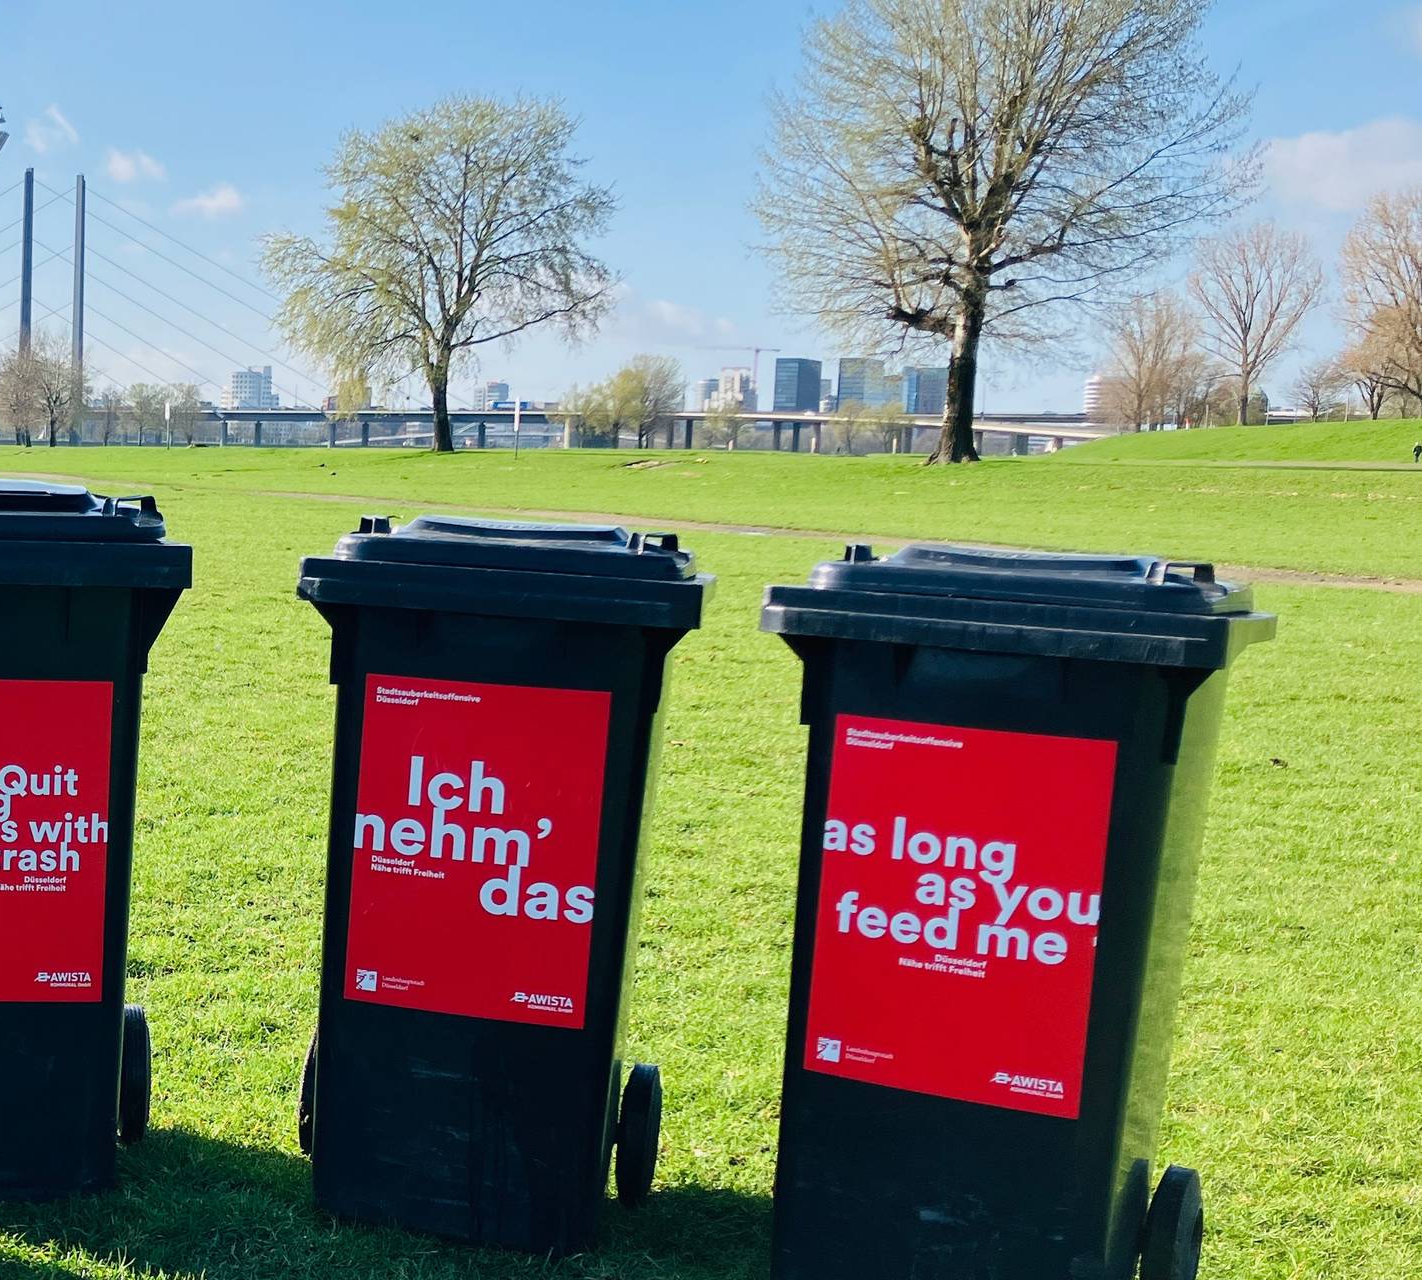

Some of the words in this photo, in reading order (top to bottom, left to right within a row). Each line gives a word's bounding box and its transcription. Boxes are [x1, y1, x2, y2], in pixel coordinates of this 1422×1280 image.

[376, 687, 481, 703] Stadtsauberkeitsoffensive
[376, 695, 418, 706] Düsseldorf
[846, 738, 893, 750] Düsseldorf
[847, 728, 963, 749] Stadtsauberkeitsoffensive
[408, 756, 505, 814] Ich
[29, 813, 108, 843] with
[823, 819, 876, 856] as
[891, 816, 1016, 884] long
[372, 855, 414, 867] Düsseldorf
[371, 863, 392, 873] Nähe
[393, 865, 412, 876] trifft
[414, 868, 445, 879] Freiheit
[24, 876, 66, 884] Düsseldorf
[36, 884, 66, 892] Freiheit
[479, 864, 595, 924] das
[915, 873, 976, 909] as
[992, 880, 1100, 926] you
[837, 891, 960, 950] feed
[977, 923, 1067, 965] me
[899, 958, 923, 969] Nähe
[924, 960, 947, 973] trifft
[949, 965, 985, 978] Freiheit
[935, 954, 987, 969] Düsseldorf
[51, 973, 91, 982] AWISTA
[529, 994, 573, 1008] AWISTA
[1011, 1075, 1063, 1093] AWISTA
